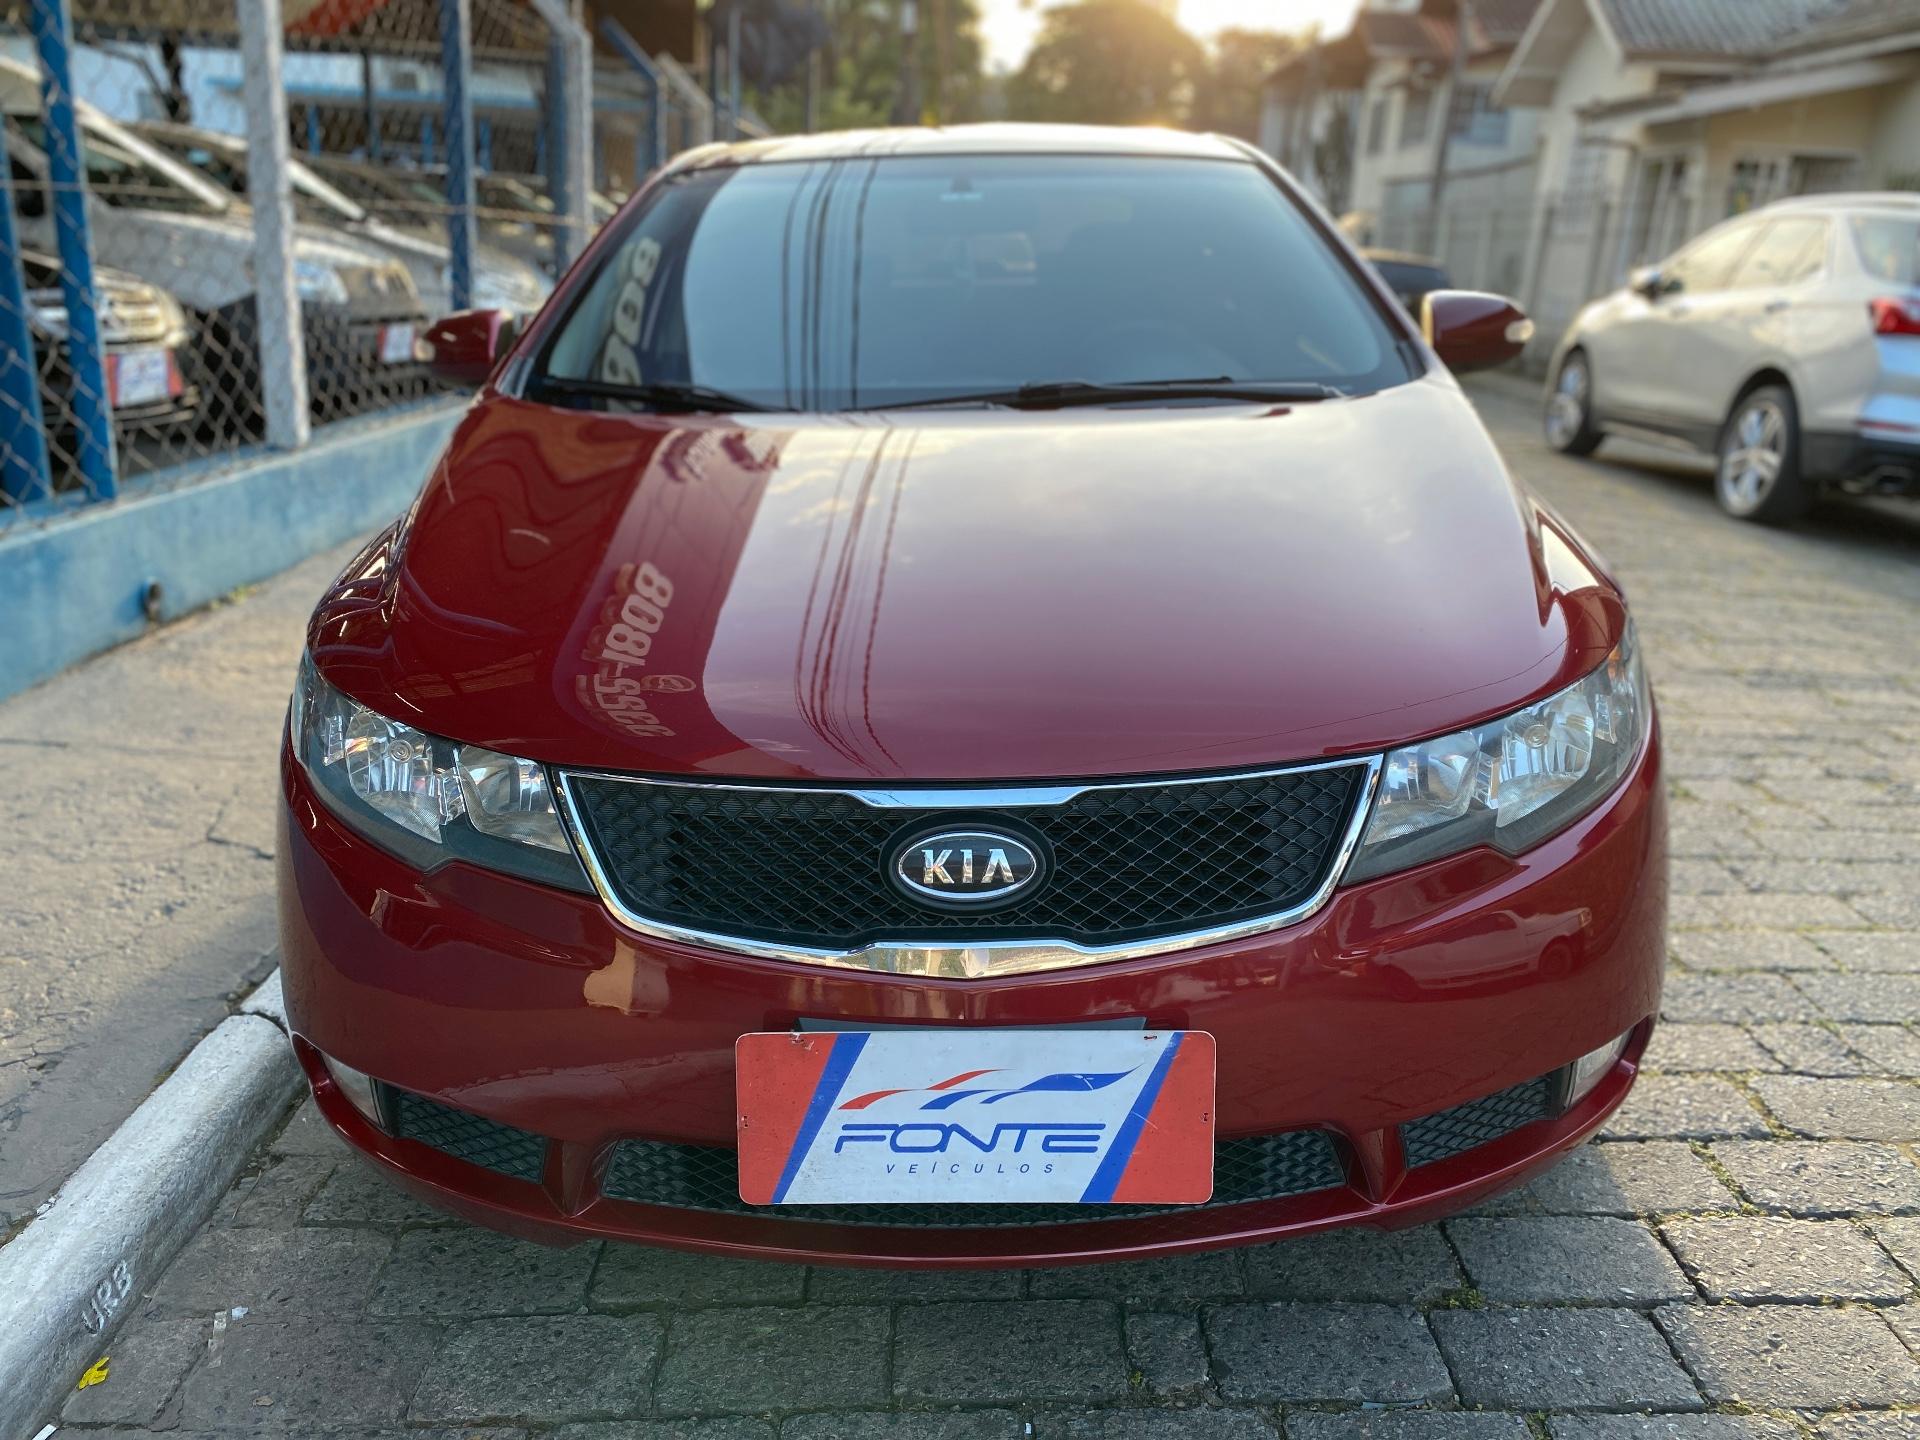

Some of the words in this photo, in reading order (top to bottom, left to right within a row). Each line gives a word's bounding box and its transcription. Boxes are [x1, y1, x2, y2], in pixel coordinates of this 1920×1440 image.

[921, 848, 1015, 884] KIA
[834, 1122, 1107, 1154] FONTE
[886, 1160, 1055, 1175] VEÍCULOS
